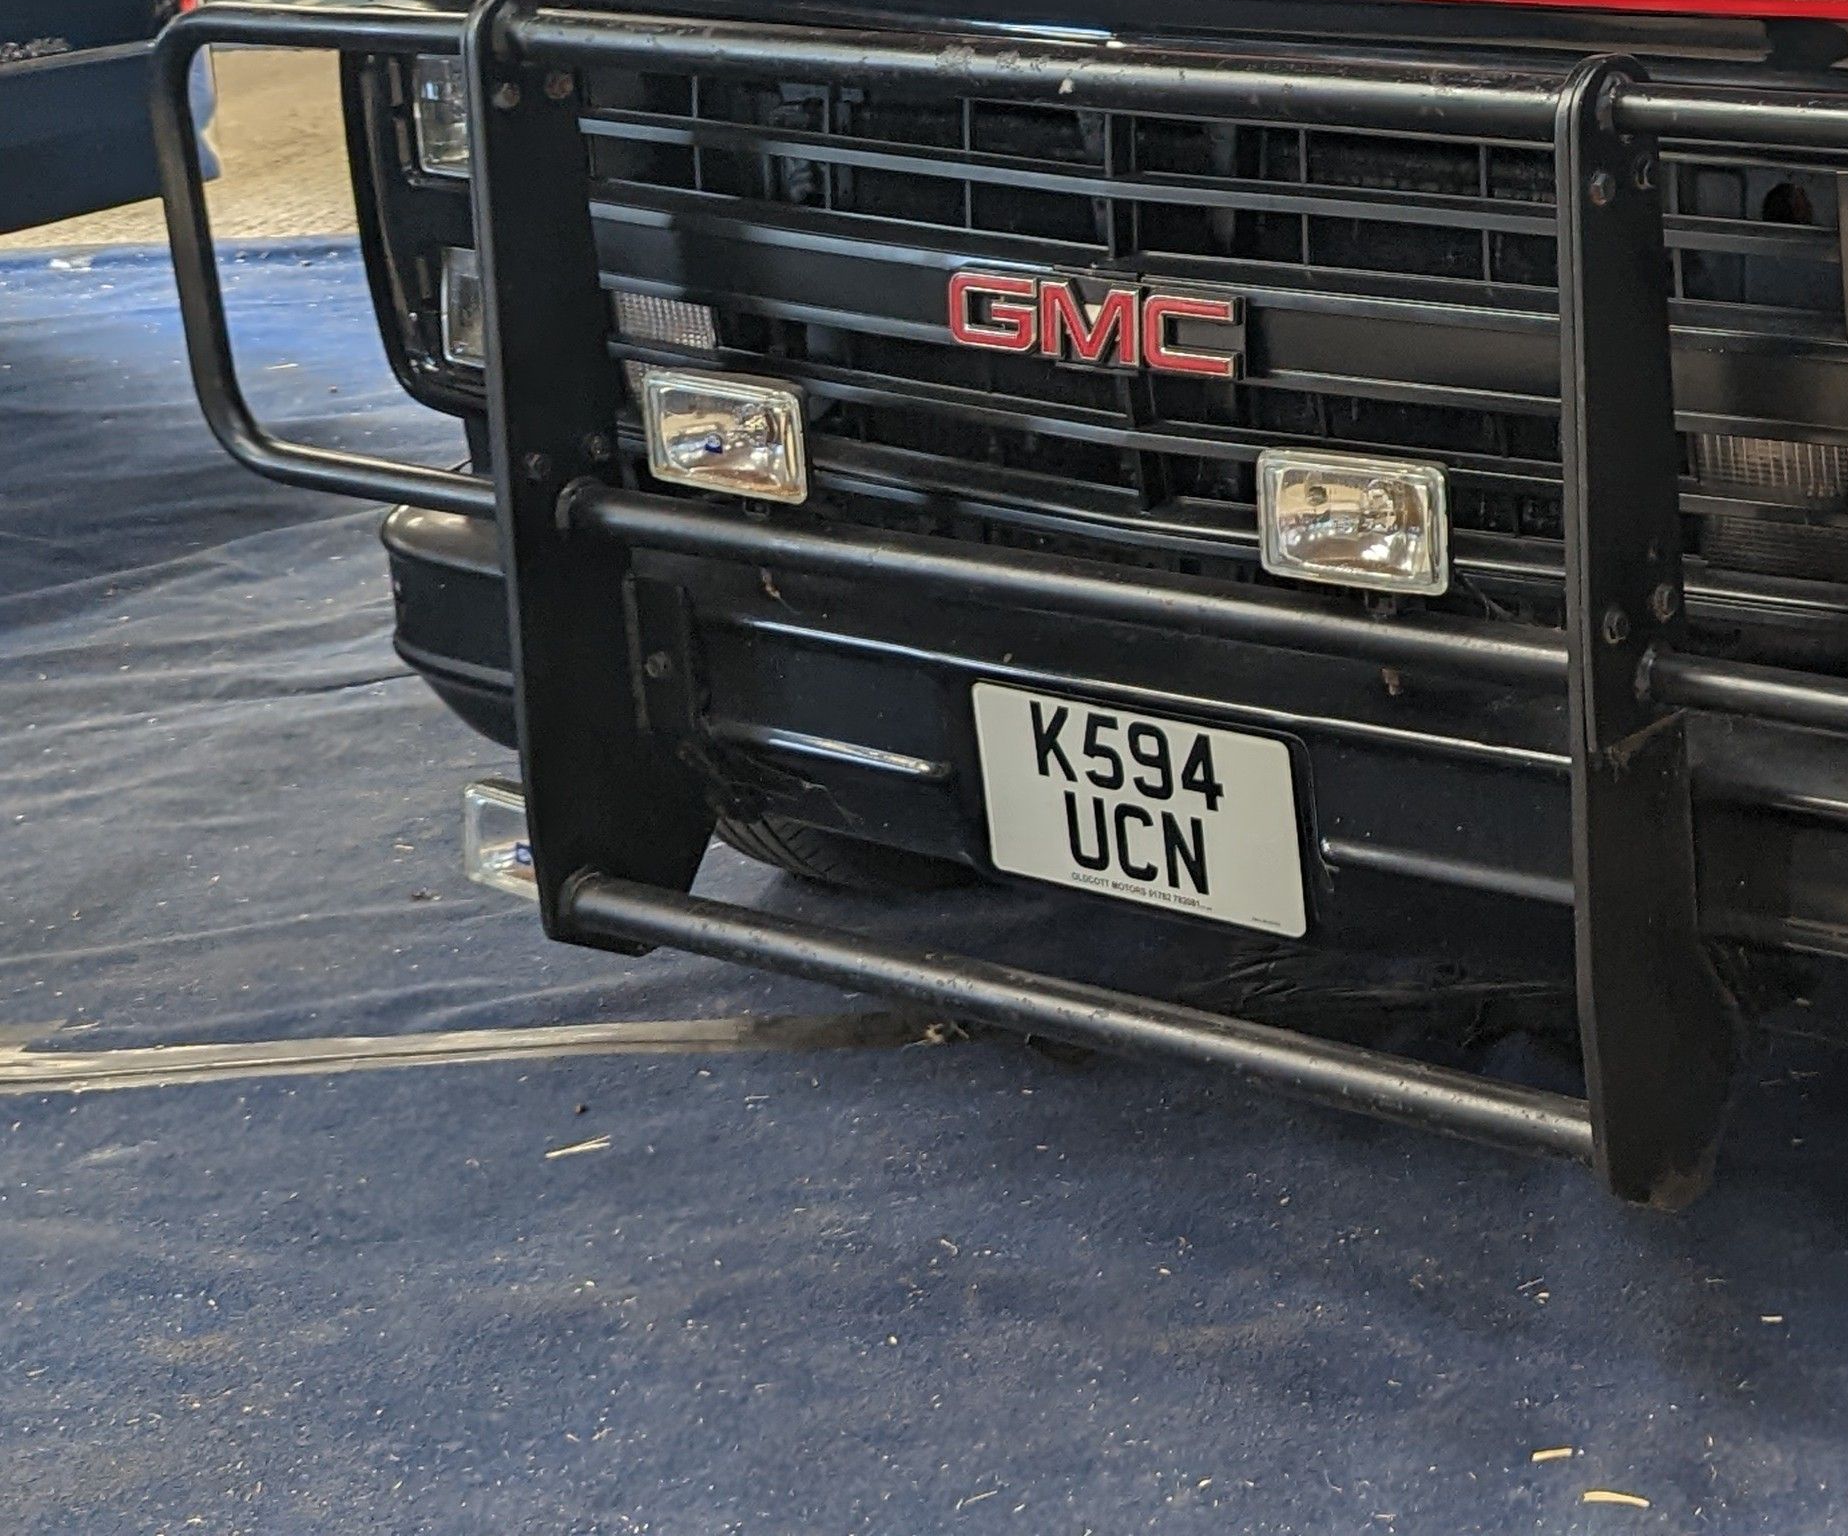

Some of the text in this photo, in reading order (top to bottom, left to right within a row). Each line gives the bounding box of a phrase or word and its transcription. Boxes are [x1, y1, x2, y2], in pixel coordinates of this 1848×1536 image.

[948, 271, 1242, 379] GMC
[1029, 700, 1224, 811] K594
[1064, 790, 1209, 895] UCN
